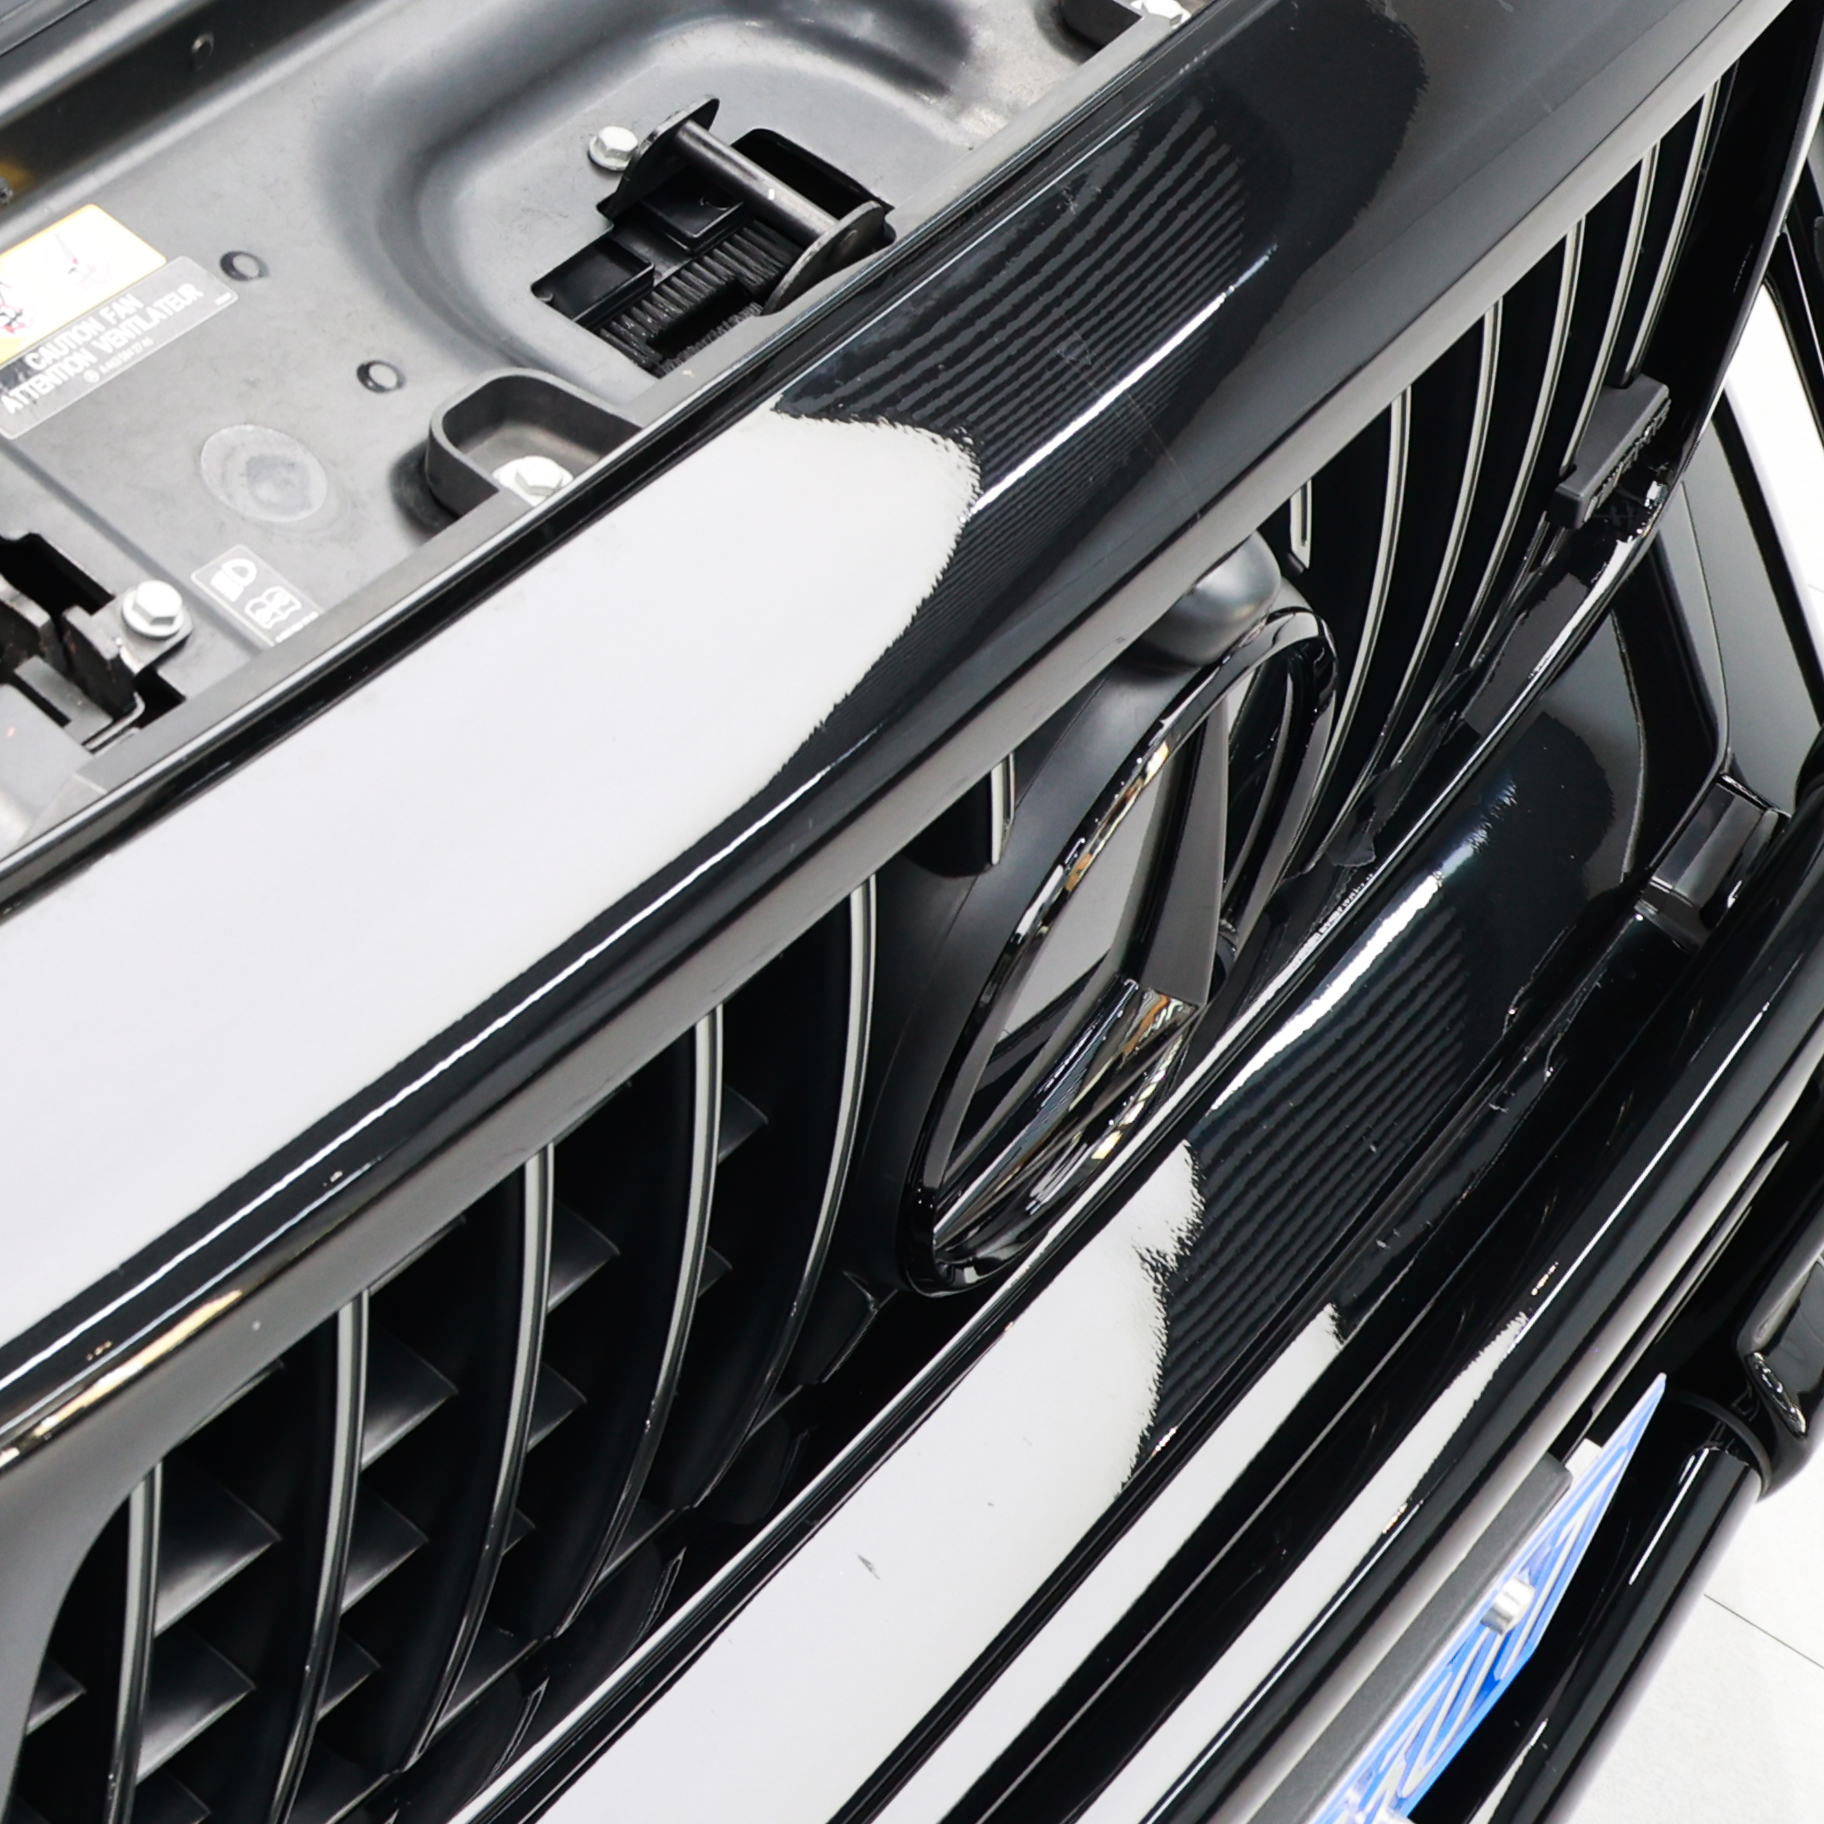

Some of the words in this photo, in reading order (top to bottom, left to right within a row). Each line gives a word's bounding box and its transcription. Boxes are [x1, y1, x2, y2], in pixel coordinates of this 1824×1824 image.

[0, 345, 98, 415] ATTENTION
[92, 282, 205, 356] VENTILATEUR
[25, 315, 105, 372] CAUTION
[99, 292, 145, 324] FAN
